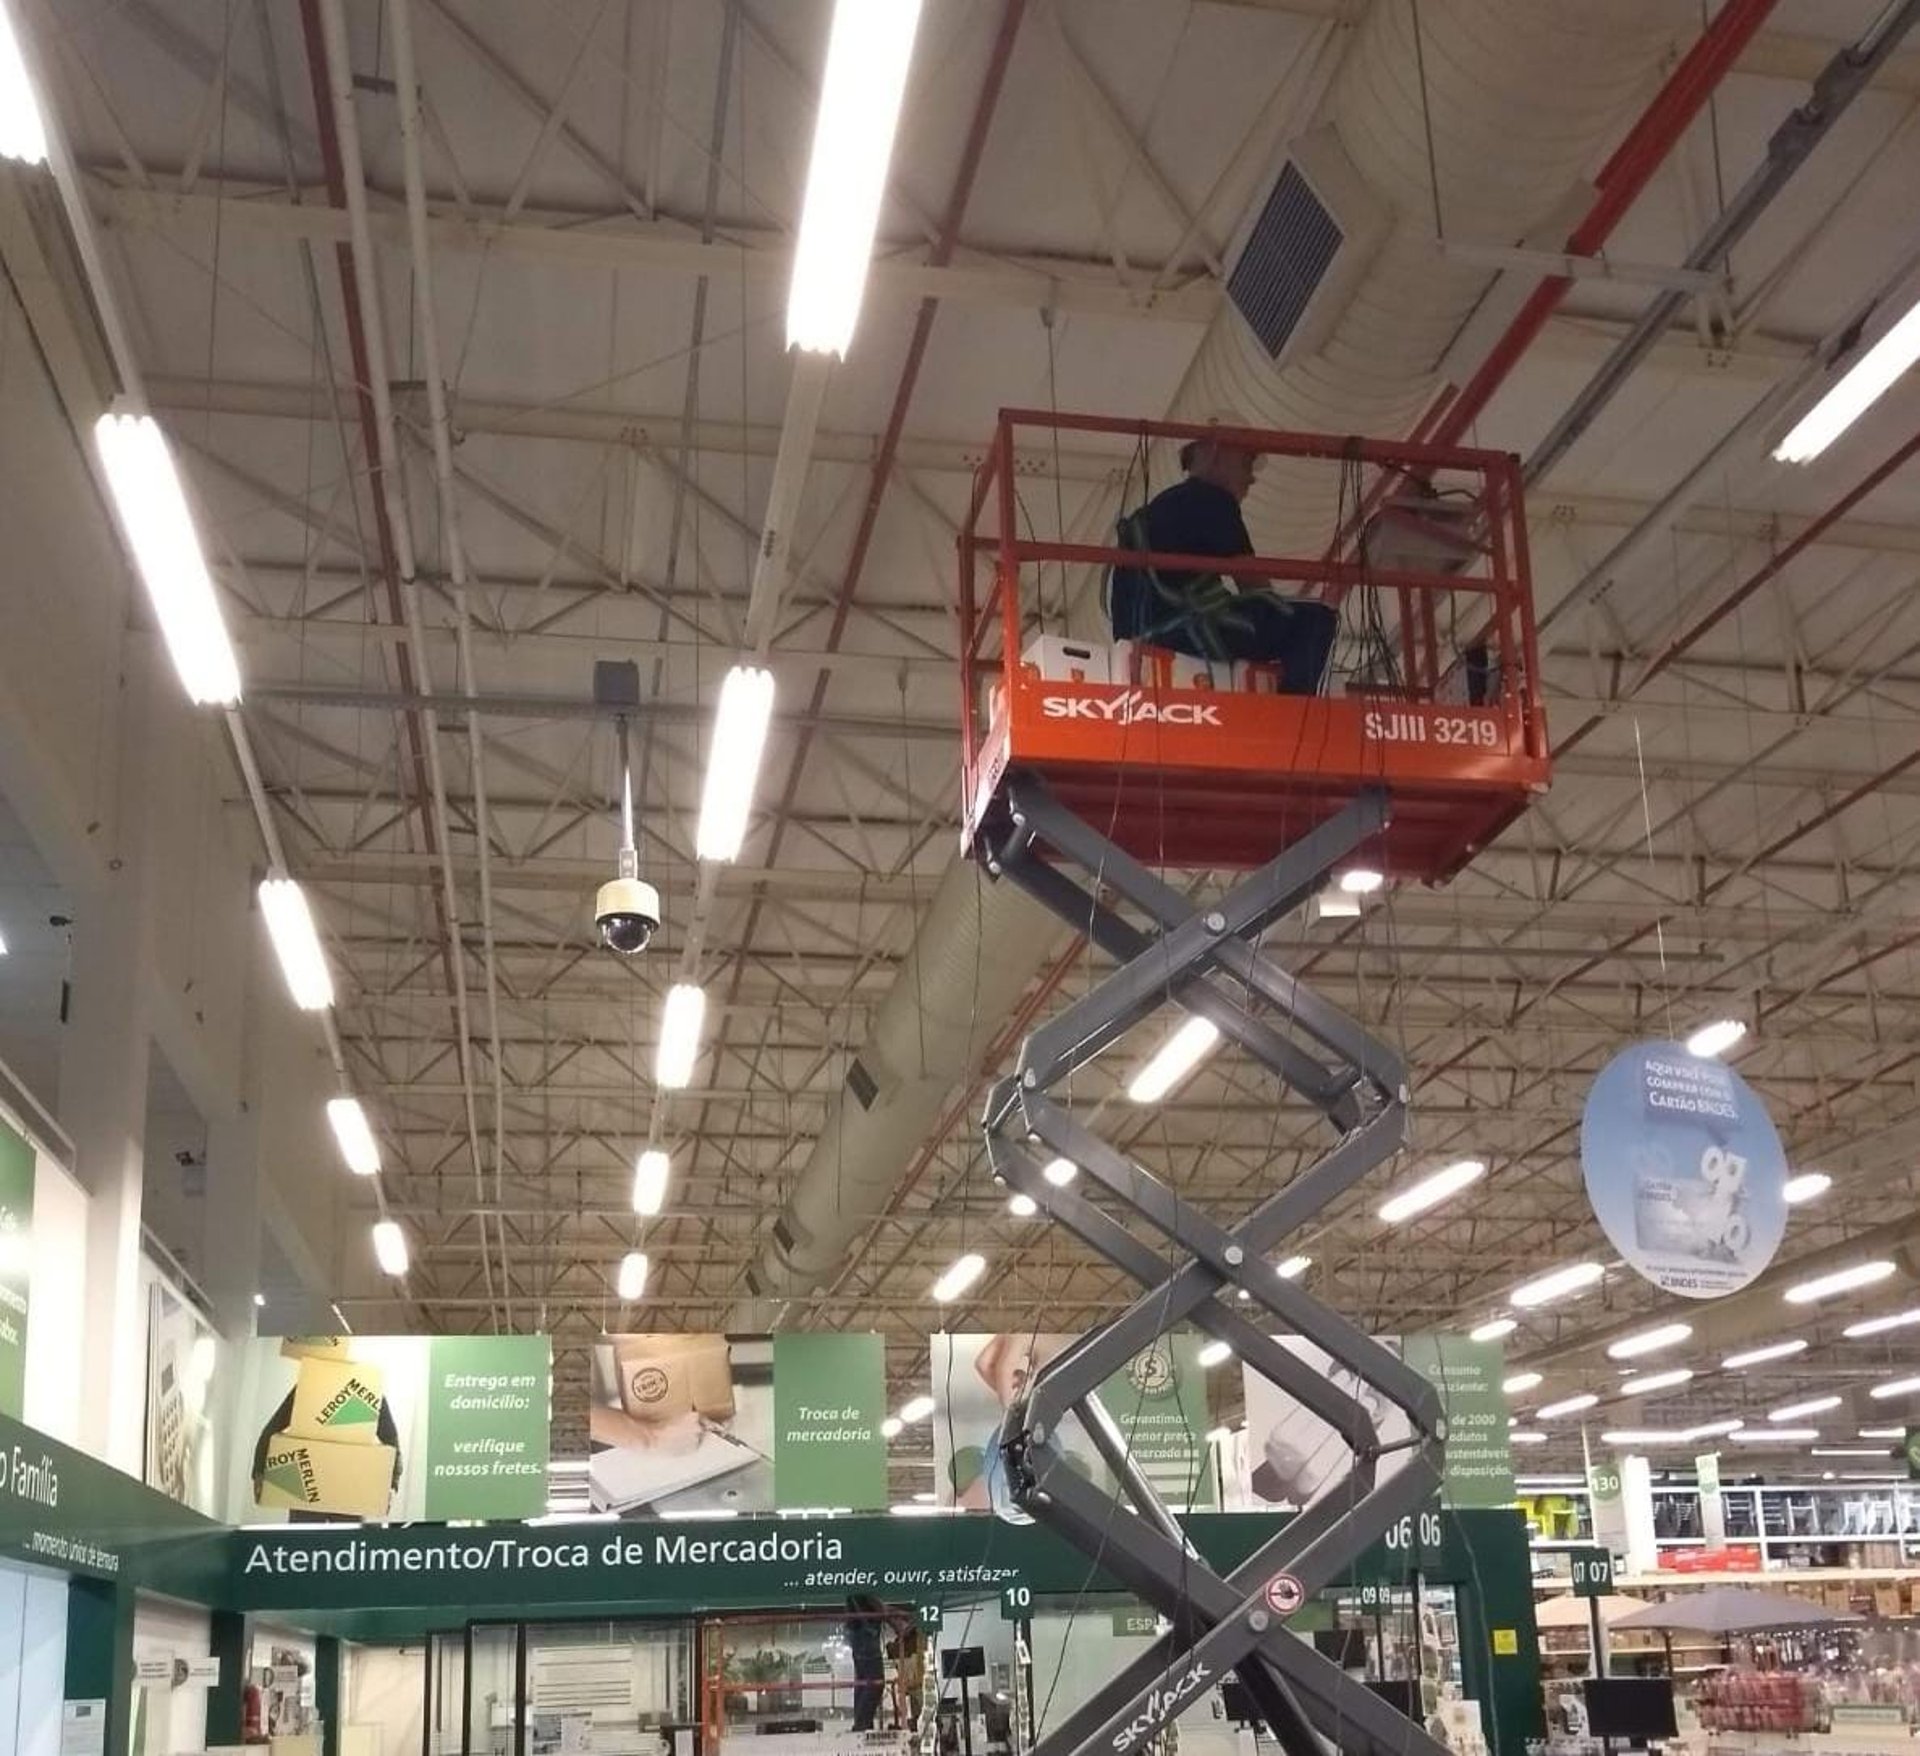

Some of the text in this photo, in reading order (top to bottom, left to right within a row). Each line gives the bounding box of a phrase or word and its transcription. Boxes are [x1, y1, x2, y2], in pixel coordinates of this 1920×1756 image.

[1042, 689, 1222, 726] SKYJACK
[1434, 716, 1498, 747] 3219
[1649, 1091, 1696, 1113] CARTÃO
[444, 1373, 535, 1393] Entrega em
[315, 1378, 381, 1425] LEROY MERL
[450, 1393, 530, 1410] domicílio:
[799, 1406, 860, 1421] Troca de
[1452, 1413, 1496, 1426] de 2000
[787, 1425, 871, 1442] mercadoria
[1449, 1431, 1488, 1443] odutos
[453, 1438, 525, 1457] verifique
[1446, 1447, 1510, 1460] ustentáveis
[11, 1445, 58, 1508] Família
[268, 1448, 321, 1504] ROY MERLIN
[434, 1459, 542, 1476] nossos fretes.
[1592, 1476, 1619, 1491] 130
[1420, 1513, 1441, 1547] 06
[245, 1531, 843, 1574] Atendimento/Troca de Mercadoria
[804, 1567, 878, 1587] atender,
[884, 1567, 930, 1584] ouvir,
[938, 1566, 1019, 1584] satisfazer
[1590, 1561, 1609, 1582] 07
[1006, 1588, 1030, 1607] 10
[1362, 1587, 1377, 1604] 09
[920, 1606, 939, 1622] 12
[1127, 1617, 1157, 1631] ESP
[1112, 1662, 1211, 1752] SKYJACK
